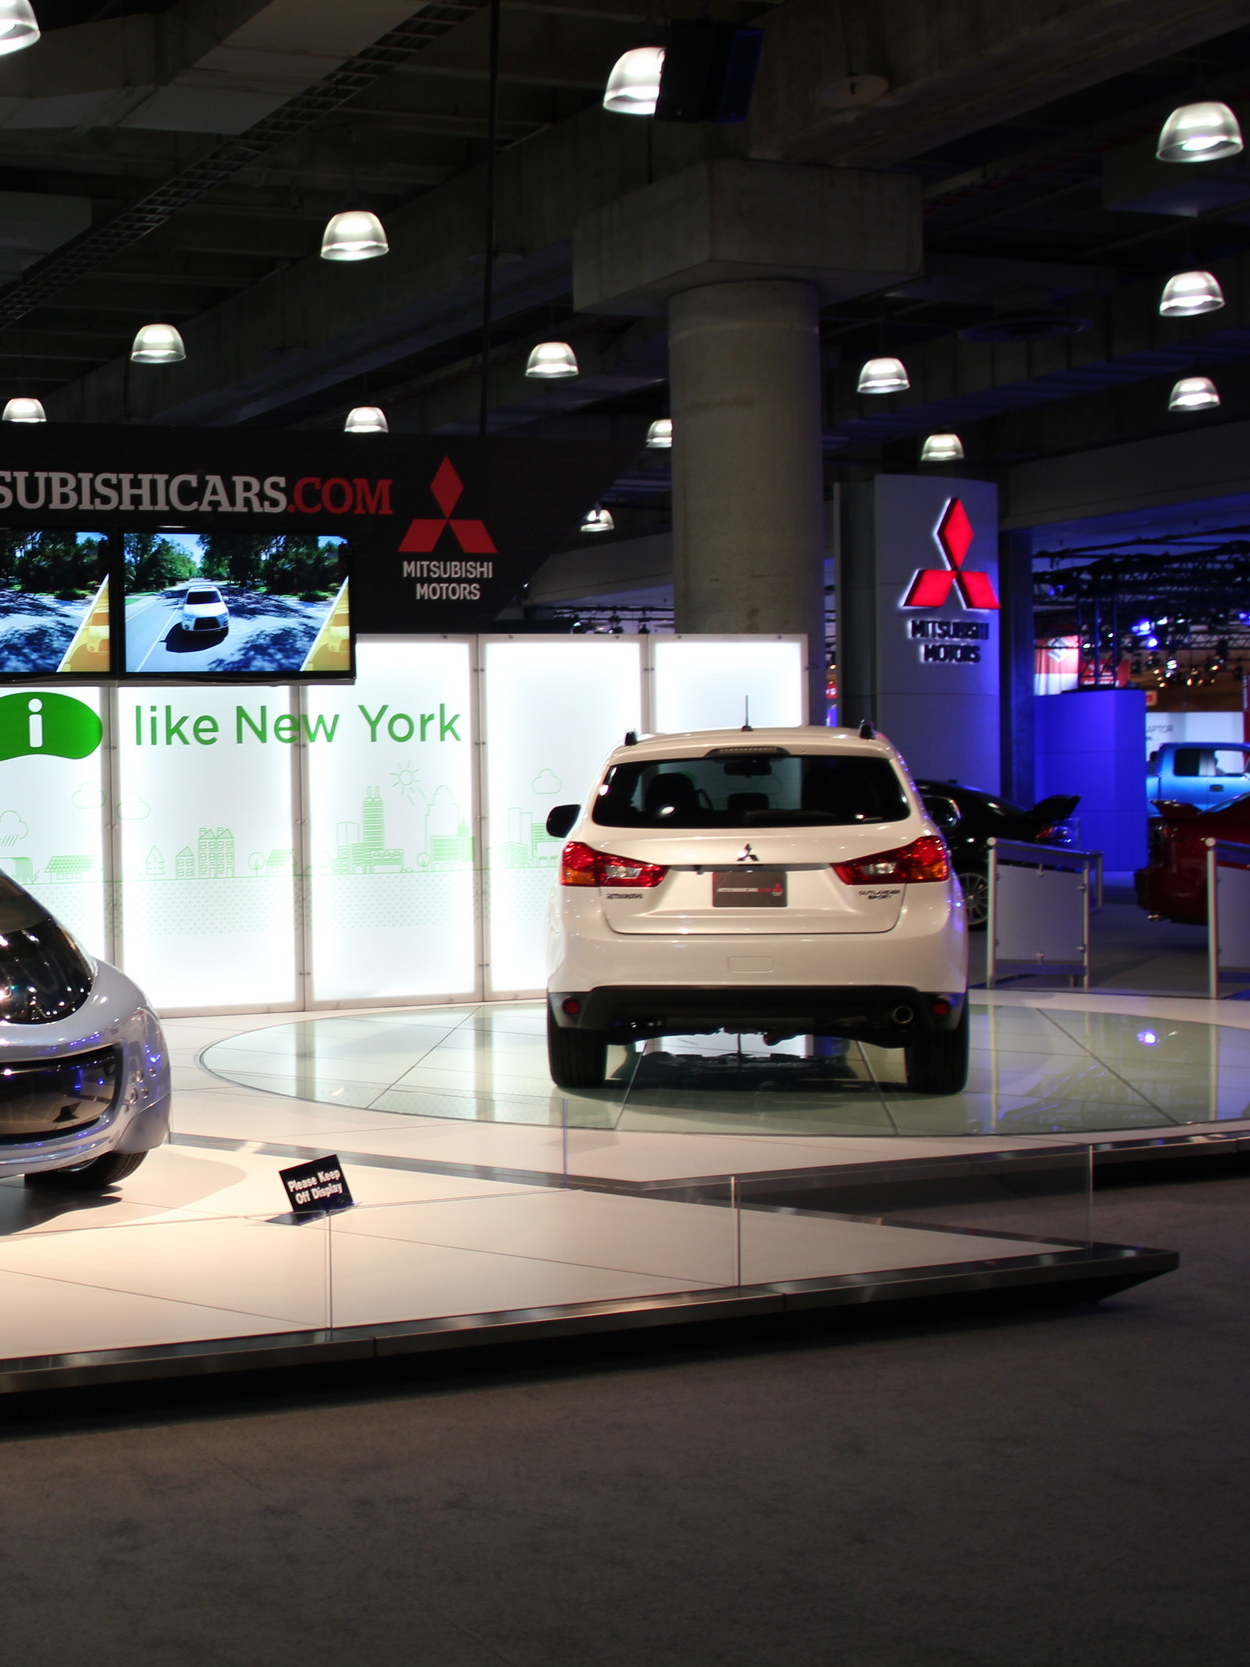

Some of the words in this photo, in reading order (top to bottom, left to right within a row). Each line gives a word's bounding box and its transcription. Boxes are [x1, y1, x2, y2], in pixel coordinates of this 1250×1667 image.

[402, 560, 493, 578] MITSUBISHI
[415, 582, 481, 600] MOTORS
[908, 618, 989, 640] MITSUBISHI
[920, 643, 982, 663] MOTORS
[134, 704, 219, 746] like
[235, 704, 340, 744] New
[357, 702, 462, 743] York
[287, 1176, 318, 1193] Please
[317, 1169, 341, 1184] Keep
[295, 1190, 311, 1205] Off
[311, 1182, 343, 1200] Display
